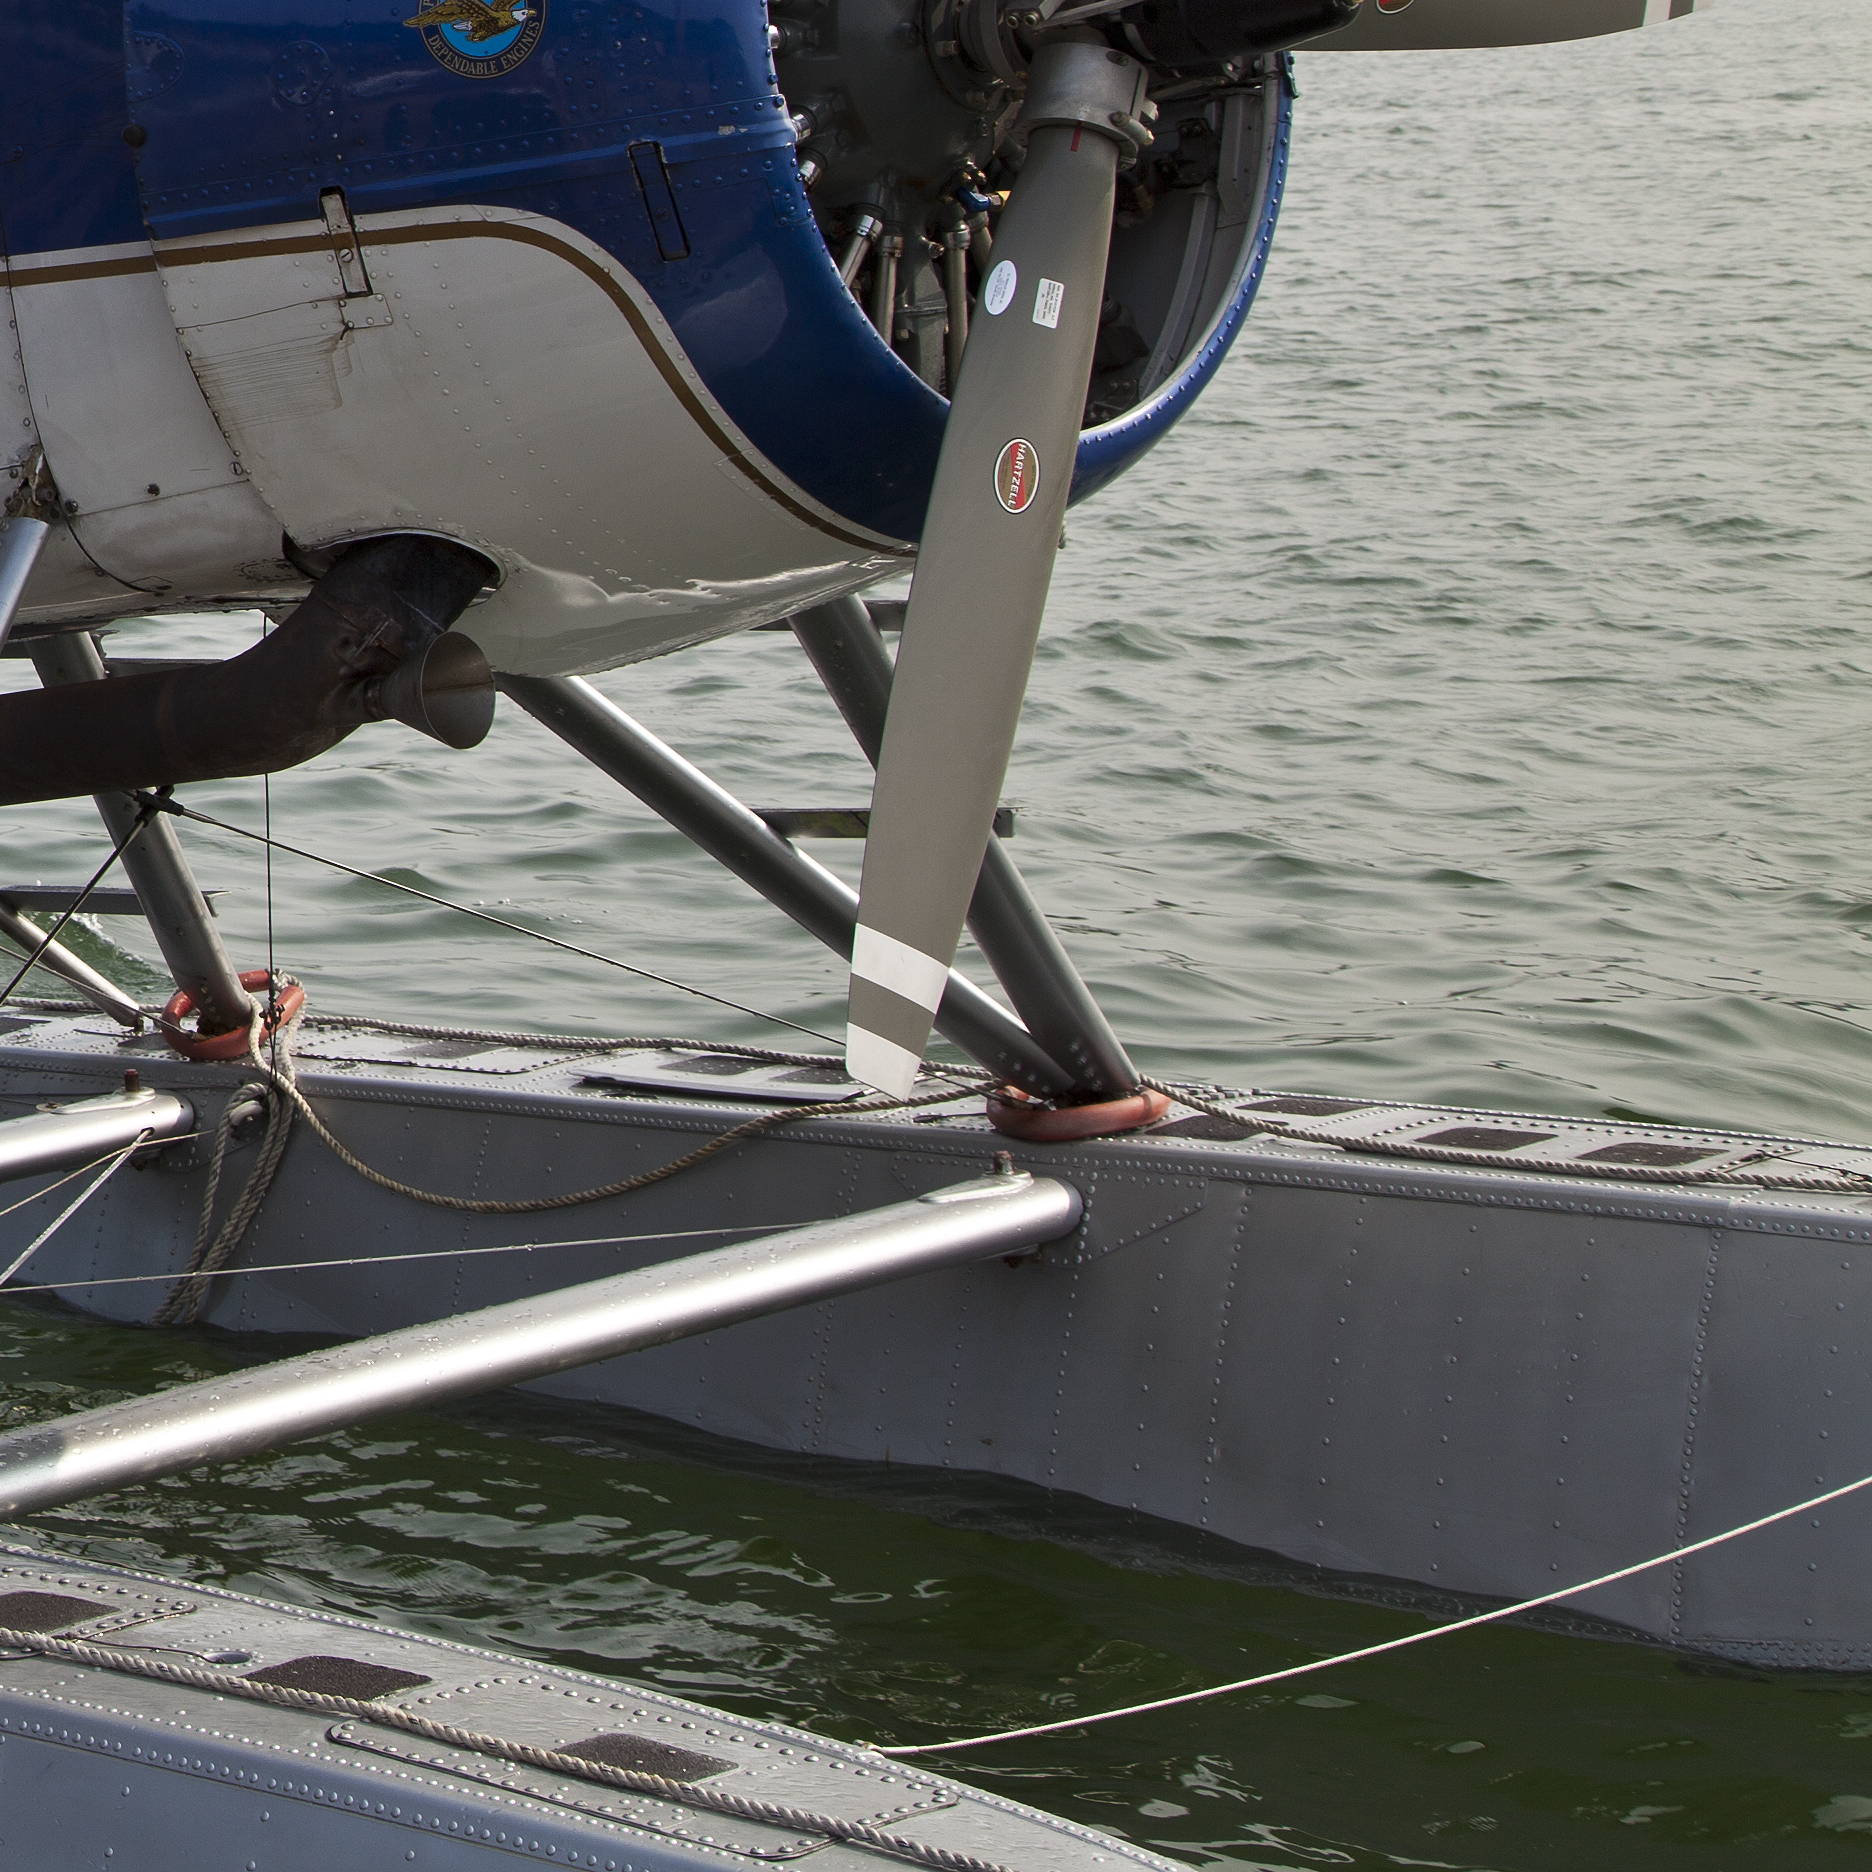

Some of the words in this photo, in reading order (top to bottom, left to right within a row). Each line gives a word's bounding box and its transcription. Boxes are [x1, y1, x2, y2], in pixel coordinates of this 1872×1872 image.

[428, 34, 498, 75] DEPENDABLE
[500, 21, 540, 69] ENGINES
[1007, 443, 1027, 506] HARTZELL
